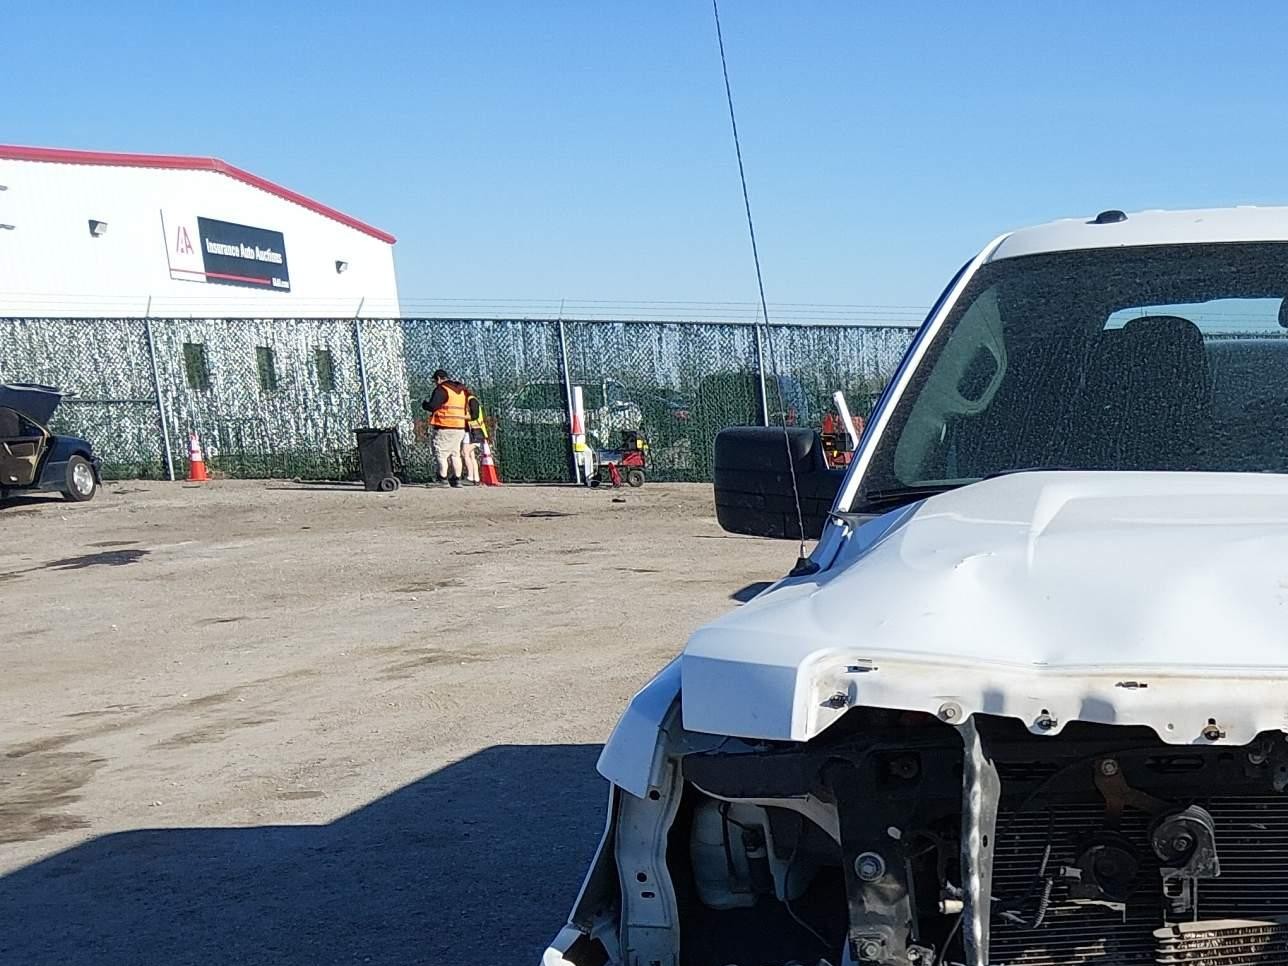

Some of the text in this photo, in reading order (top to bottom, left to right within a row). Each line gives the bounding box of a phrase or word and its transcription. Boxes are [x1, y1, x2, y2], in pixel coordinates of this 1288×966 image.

[205, 238, 283, 265] Insurance Auto Auctions
